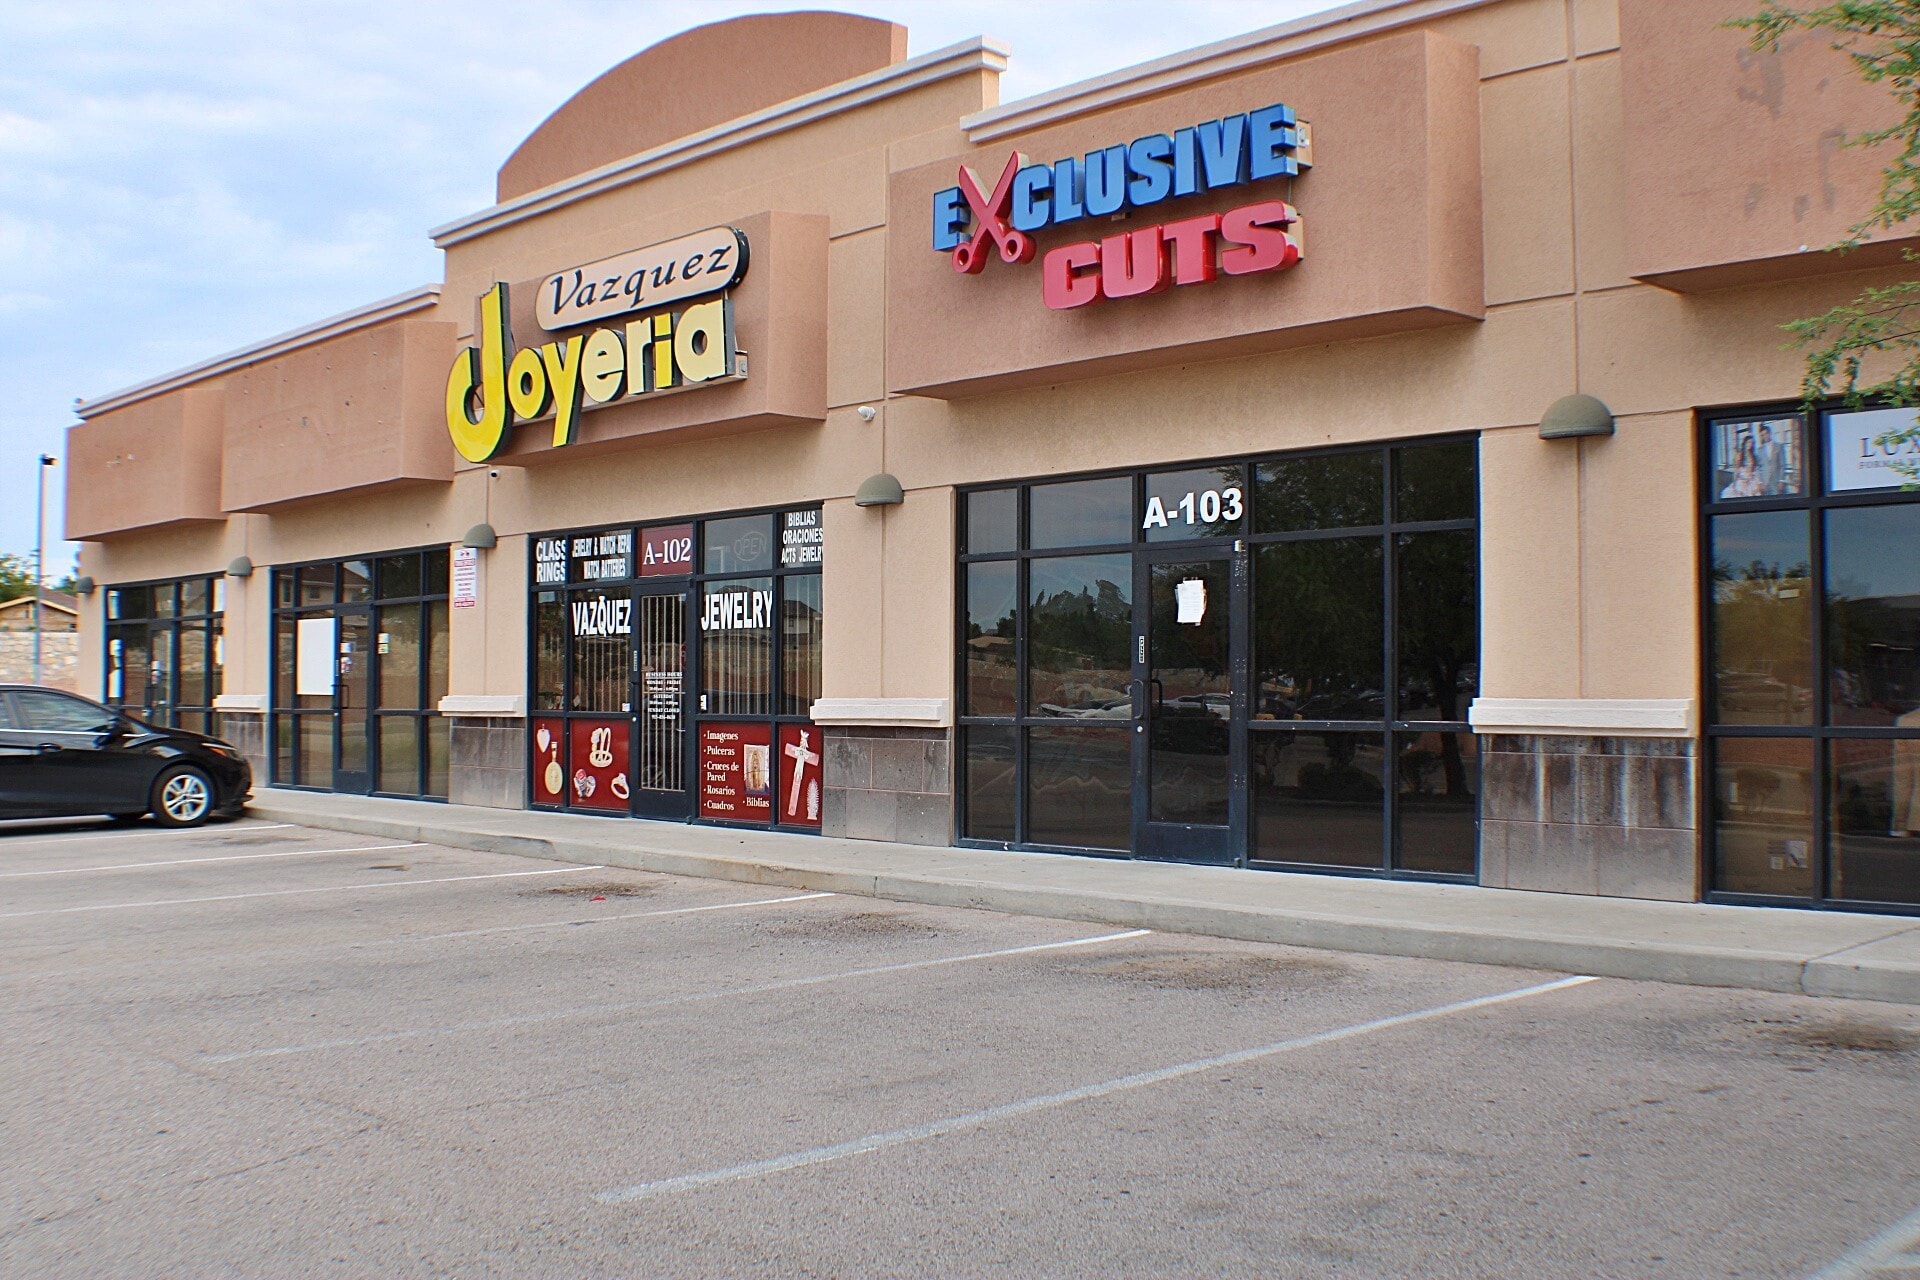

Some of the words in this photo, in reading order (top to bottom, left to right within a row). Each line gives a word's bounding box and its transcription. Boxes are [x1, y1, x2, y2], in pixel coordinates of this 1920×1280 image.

[933, 103, 1298, 274] EXCLUSIVE
[1043, 200, 1298, 310] CUTS
[550, 245, 732, 315] Vazquez
[446, 281, 734, 463] Joyeria
[1143, 487, 1244, 529] A-103
[788, 511, 816, 526] BIBLIAS
[782, 528, 823, 544] ORACIONES
[536, 540, 566, 562] CLASS
[643, 537, 691, 566] A-102
[781, 547, 796, 564] ACTS
[799, 546, 823, 563] JEWELR
[536, 561, 566, 582] RINGS
[572, 595, 632, 637] VAZQUEZ
[701, 591, 773, 631] JEWELRY
[707, 730, 739, 744] Imagenes
[706, 745, 736, 756] Pulceras
[706, 761, 730, 771] Cruces
[730, 762, 740, 771] de
[707, 772, 726, 782] Pared
[707, 784, 736, 796] Rosarios
[706, 800, 735, 811] Cuadros
[746, 797, 770, 808] Biblias
